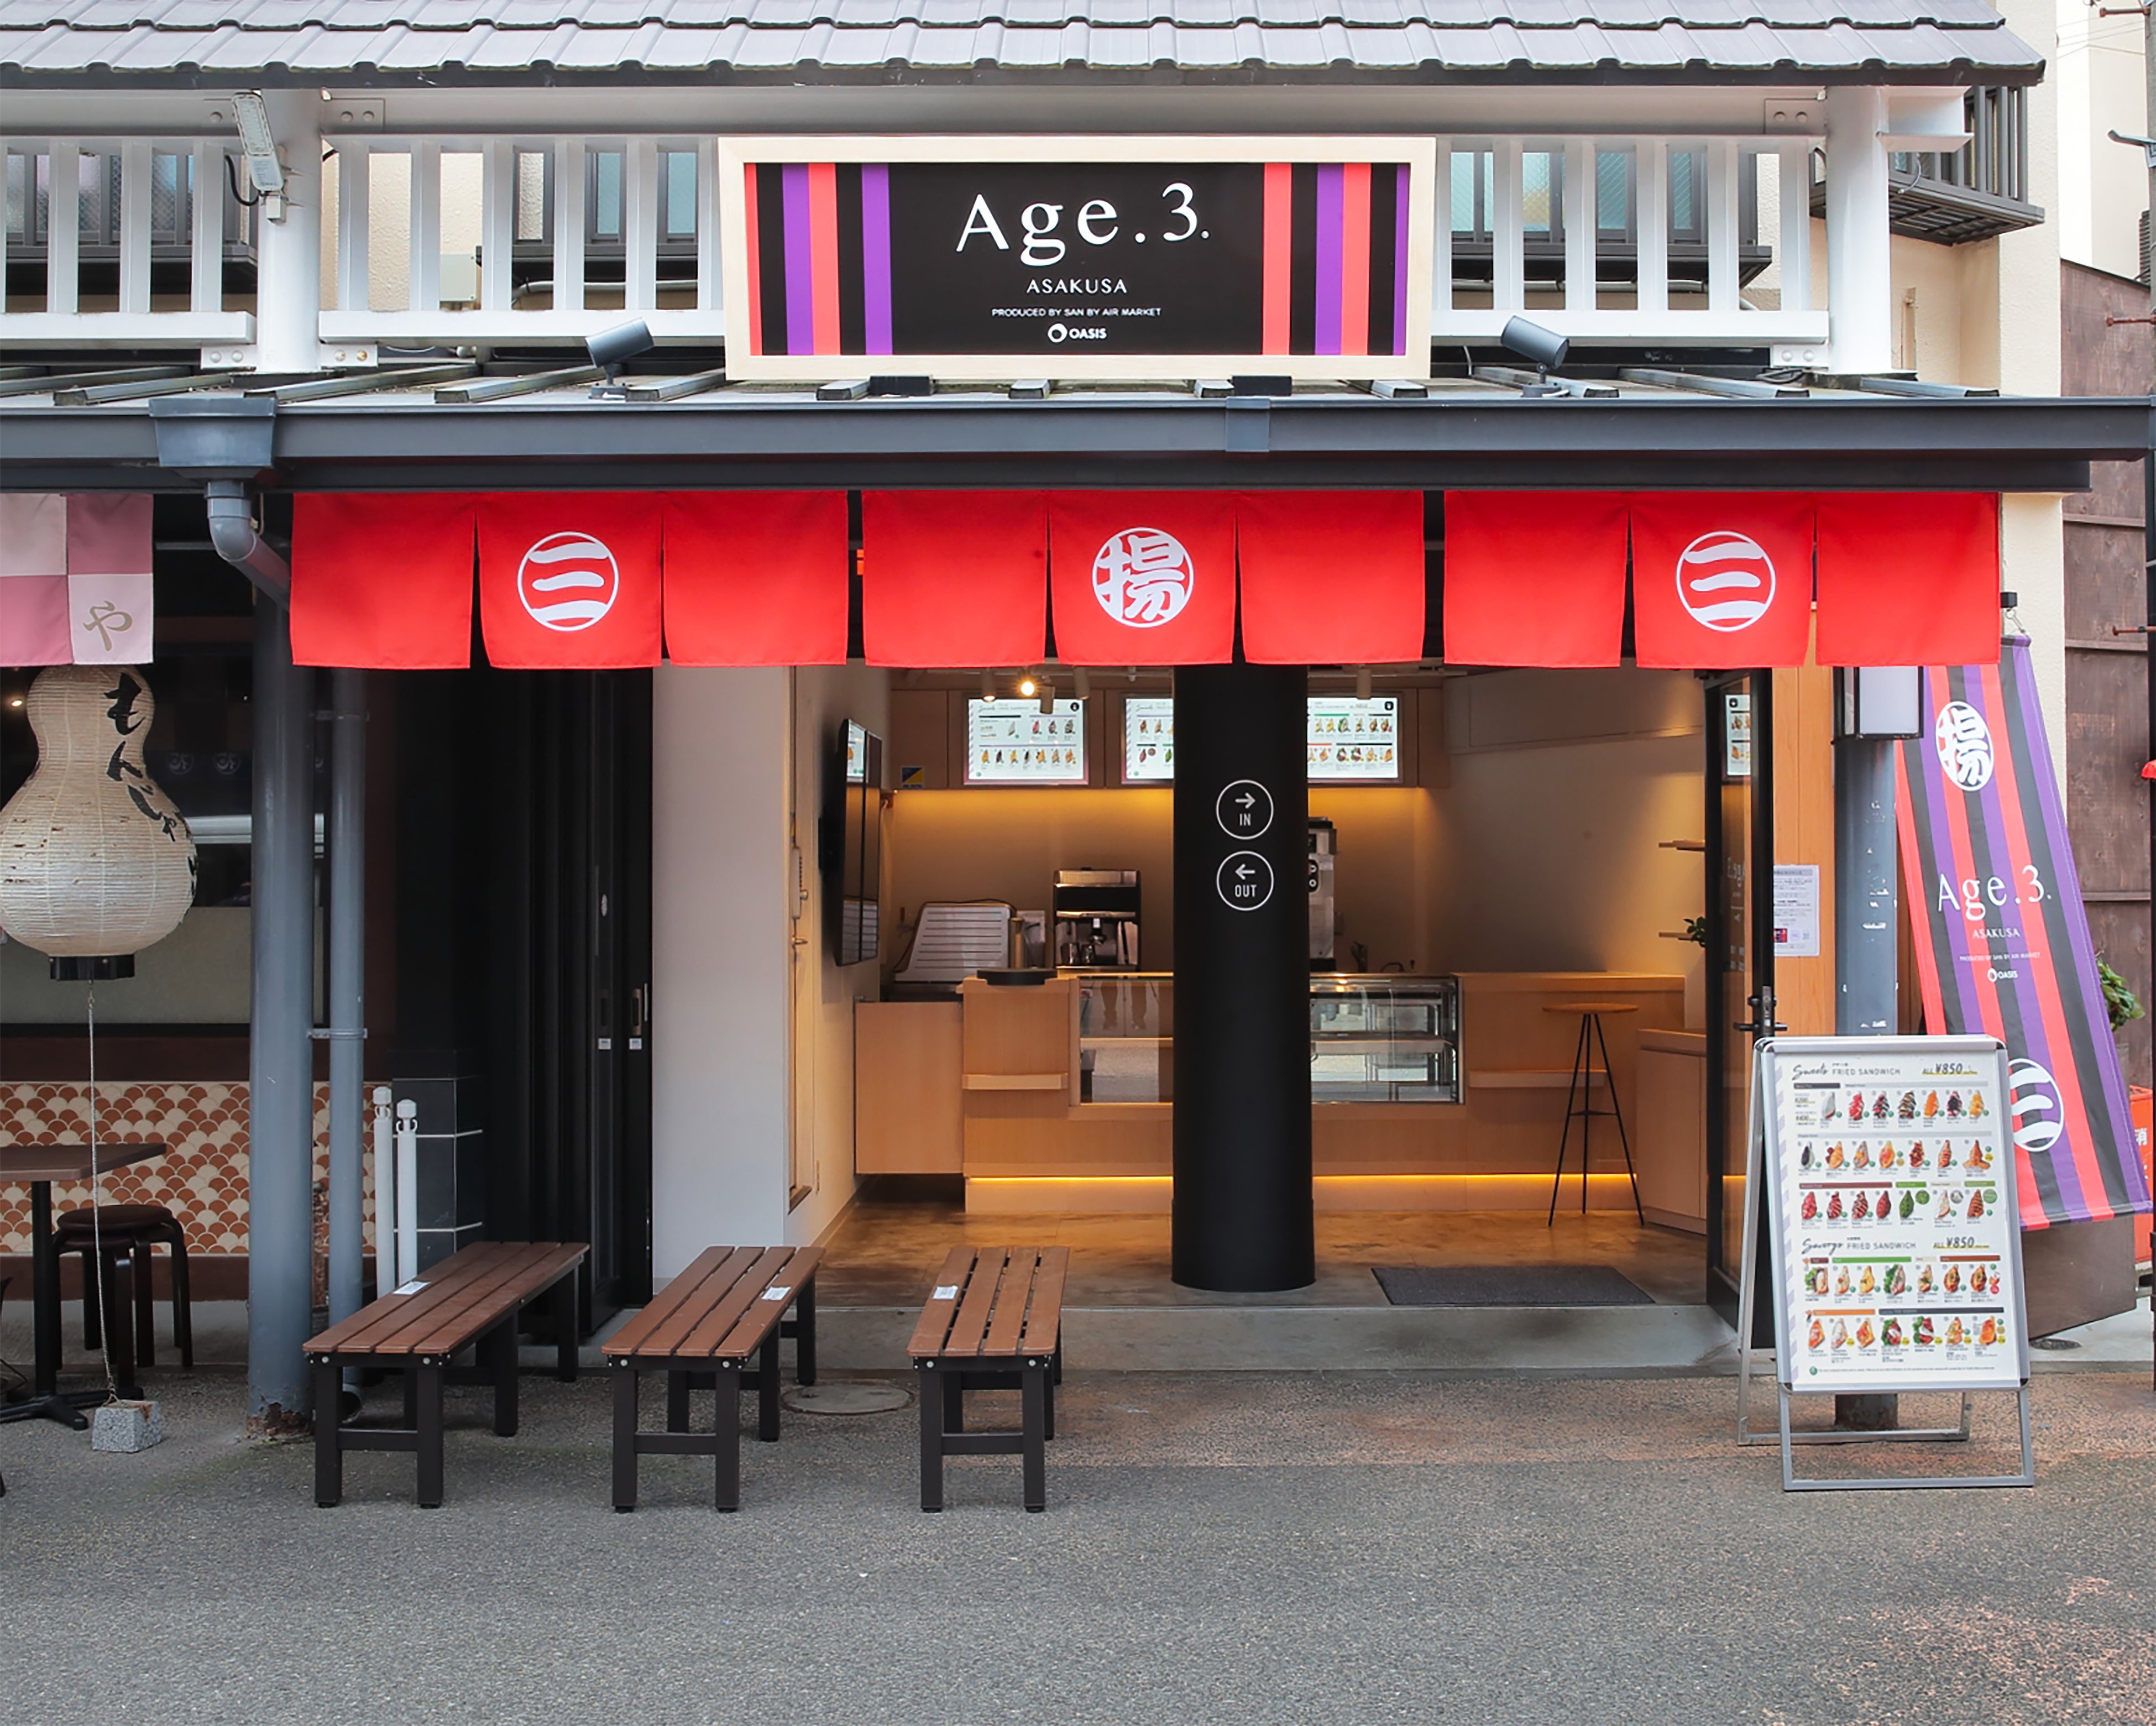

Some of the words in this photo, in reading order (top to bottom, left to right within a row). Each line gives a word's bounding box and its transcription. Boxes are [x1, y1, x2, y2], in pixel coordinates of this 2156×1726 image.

[1026, 278, 1128, 294] ASAKUSA
[991, 308, 1046, 317] PRODUCED
[1048, 308, 1061, 316] BY
[1064, 308, 1084, 316] SAN
[1086, 308, 1100, 316] BY
[1102, 308, 1118, 316] AIR
[1121, 307, 1161, 316] MARKET
[1069, 328, 1107, 339] OASIS
[1092, 527, 1194, 627] 揚
[83, 599, 133, 651] や
[1935, 701, 1994, 791] 揚
[1239, 813, 1252, 827] IN
[1234, 884, 1257, 898] OUT
[1972, 928, 2021, 939] ASAKUSA
[1935, 1063, 1963, 1074] ¥850
[1946, 1236, 1975, 1248] ¥850
